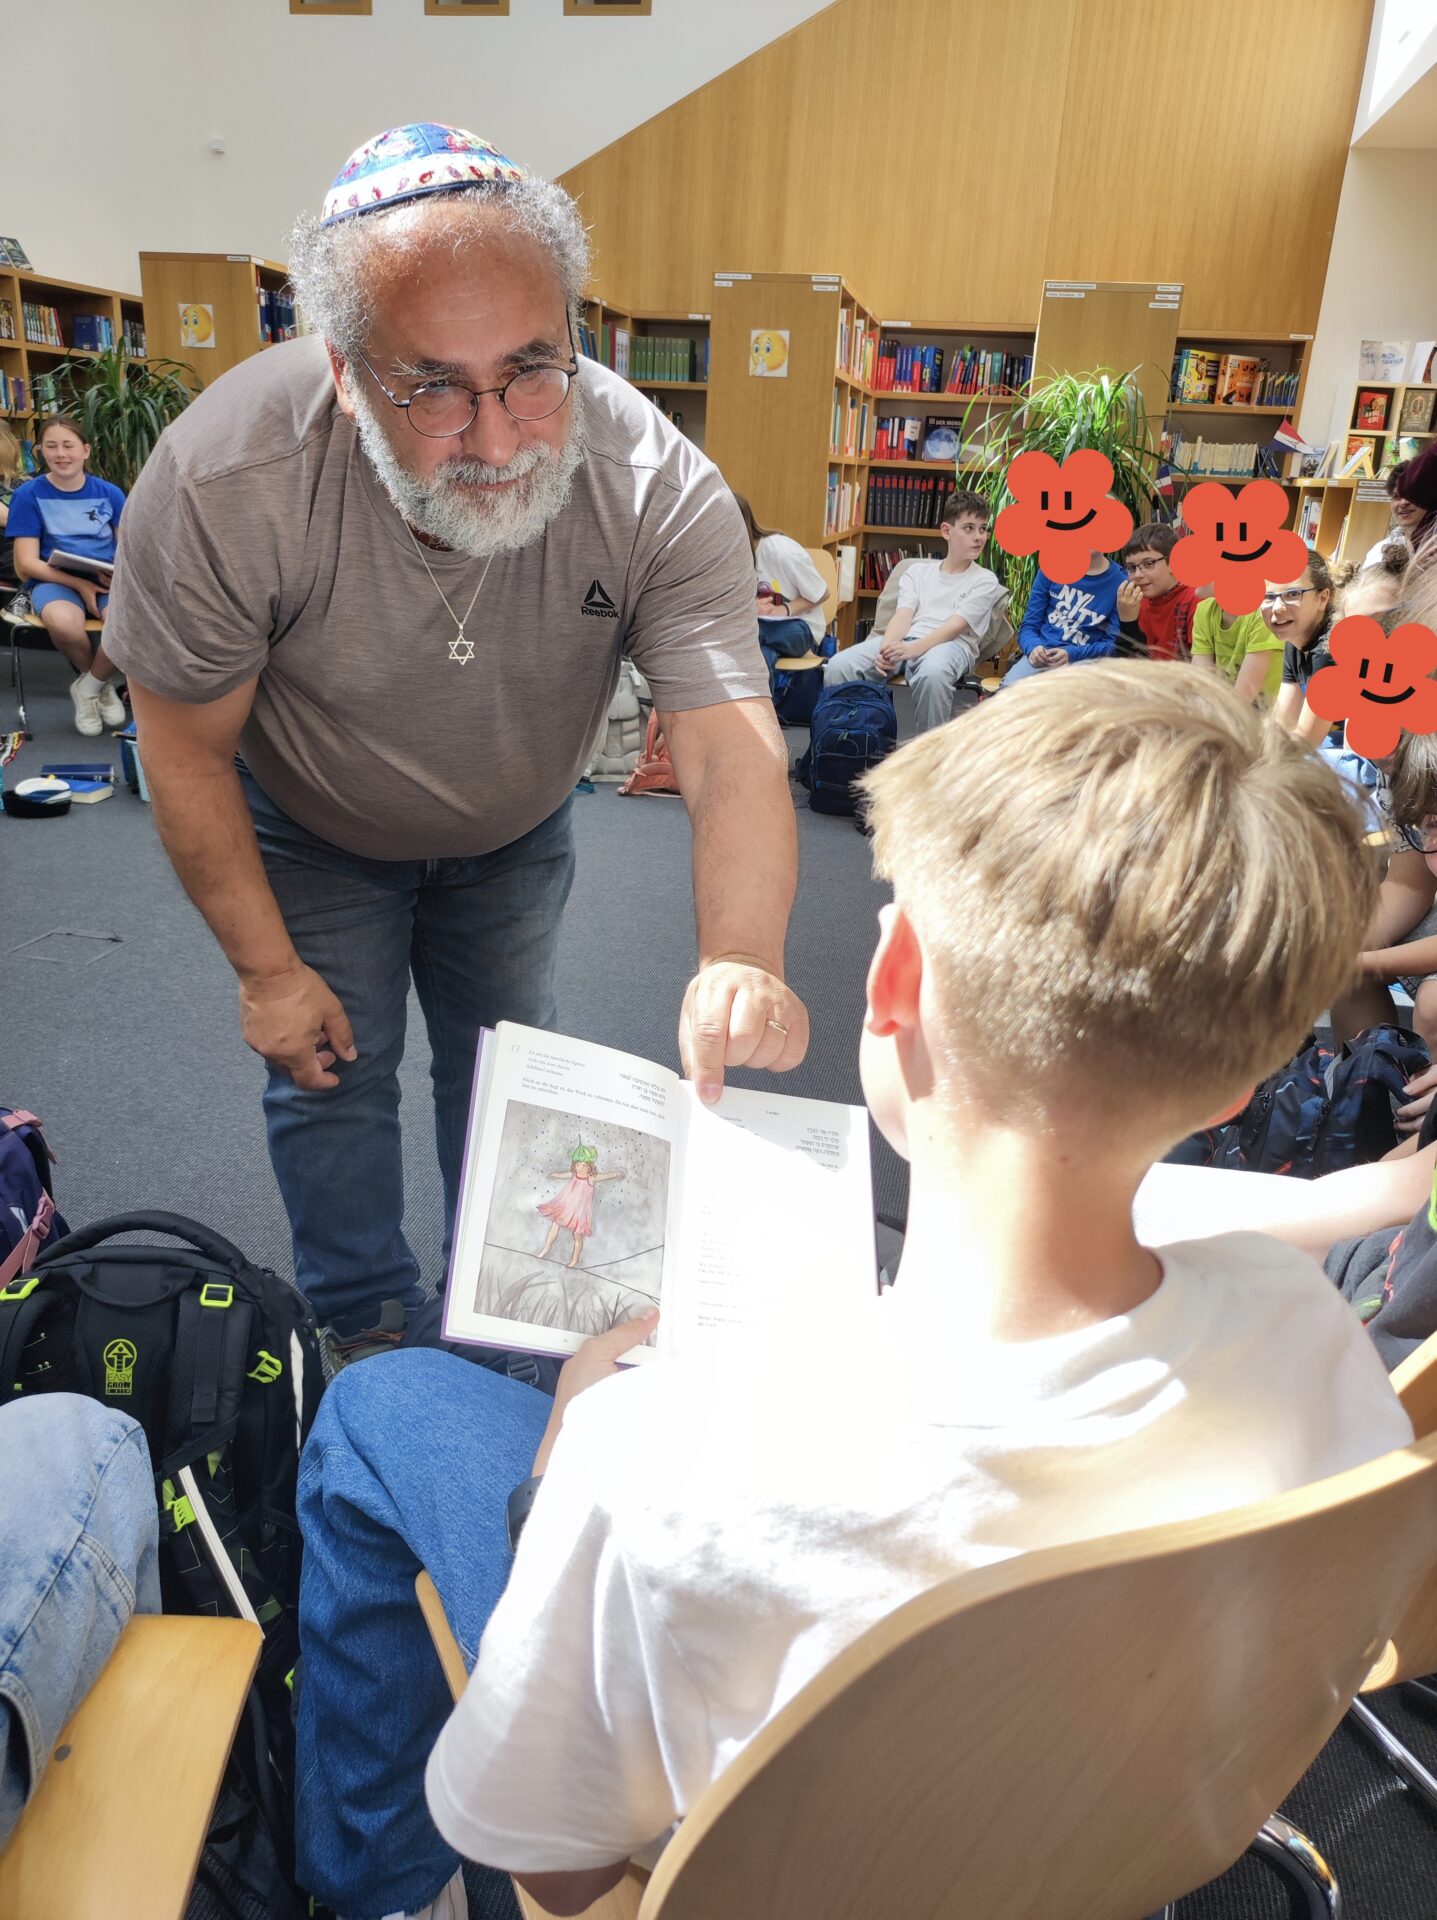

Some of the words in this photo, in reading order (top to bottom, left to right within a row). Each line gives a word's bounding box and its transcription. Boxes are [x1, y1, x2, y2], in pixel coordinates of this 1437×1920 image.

[581, 606, 620, 619] Reebok
[1056, 601, 1106, 629] CITY
[107, 1373, 131, 1382] EASY
